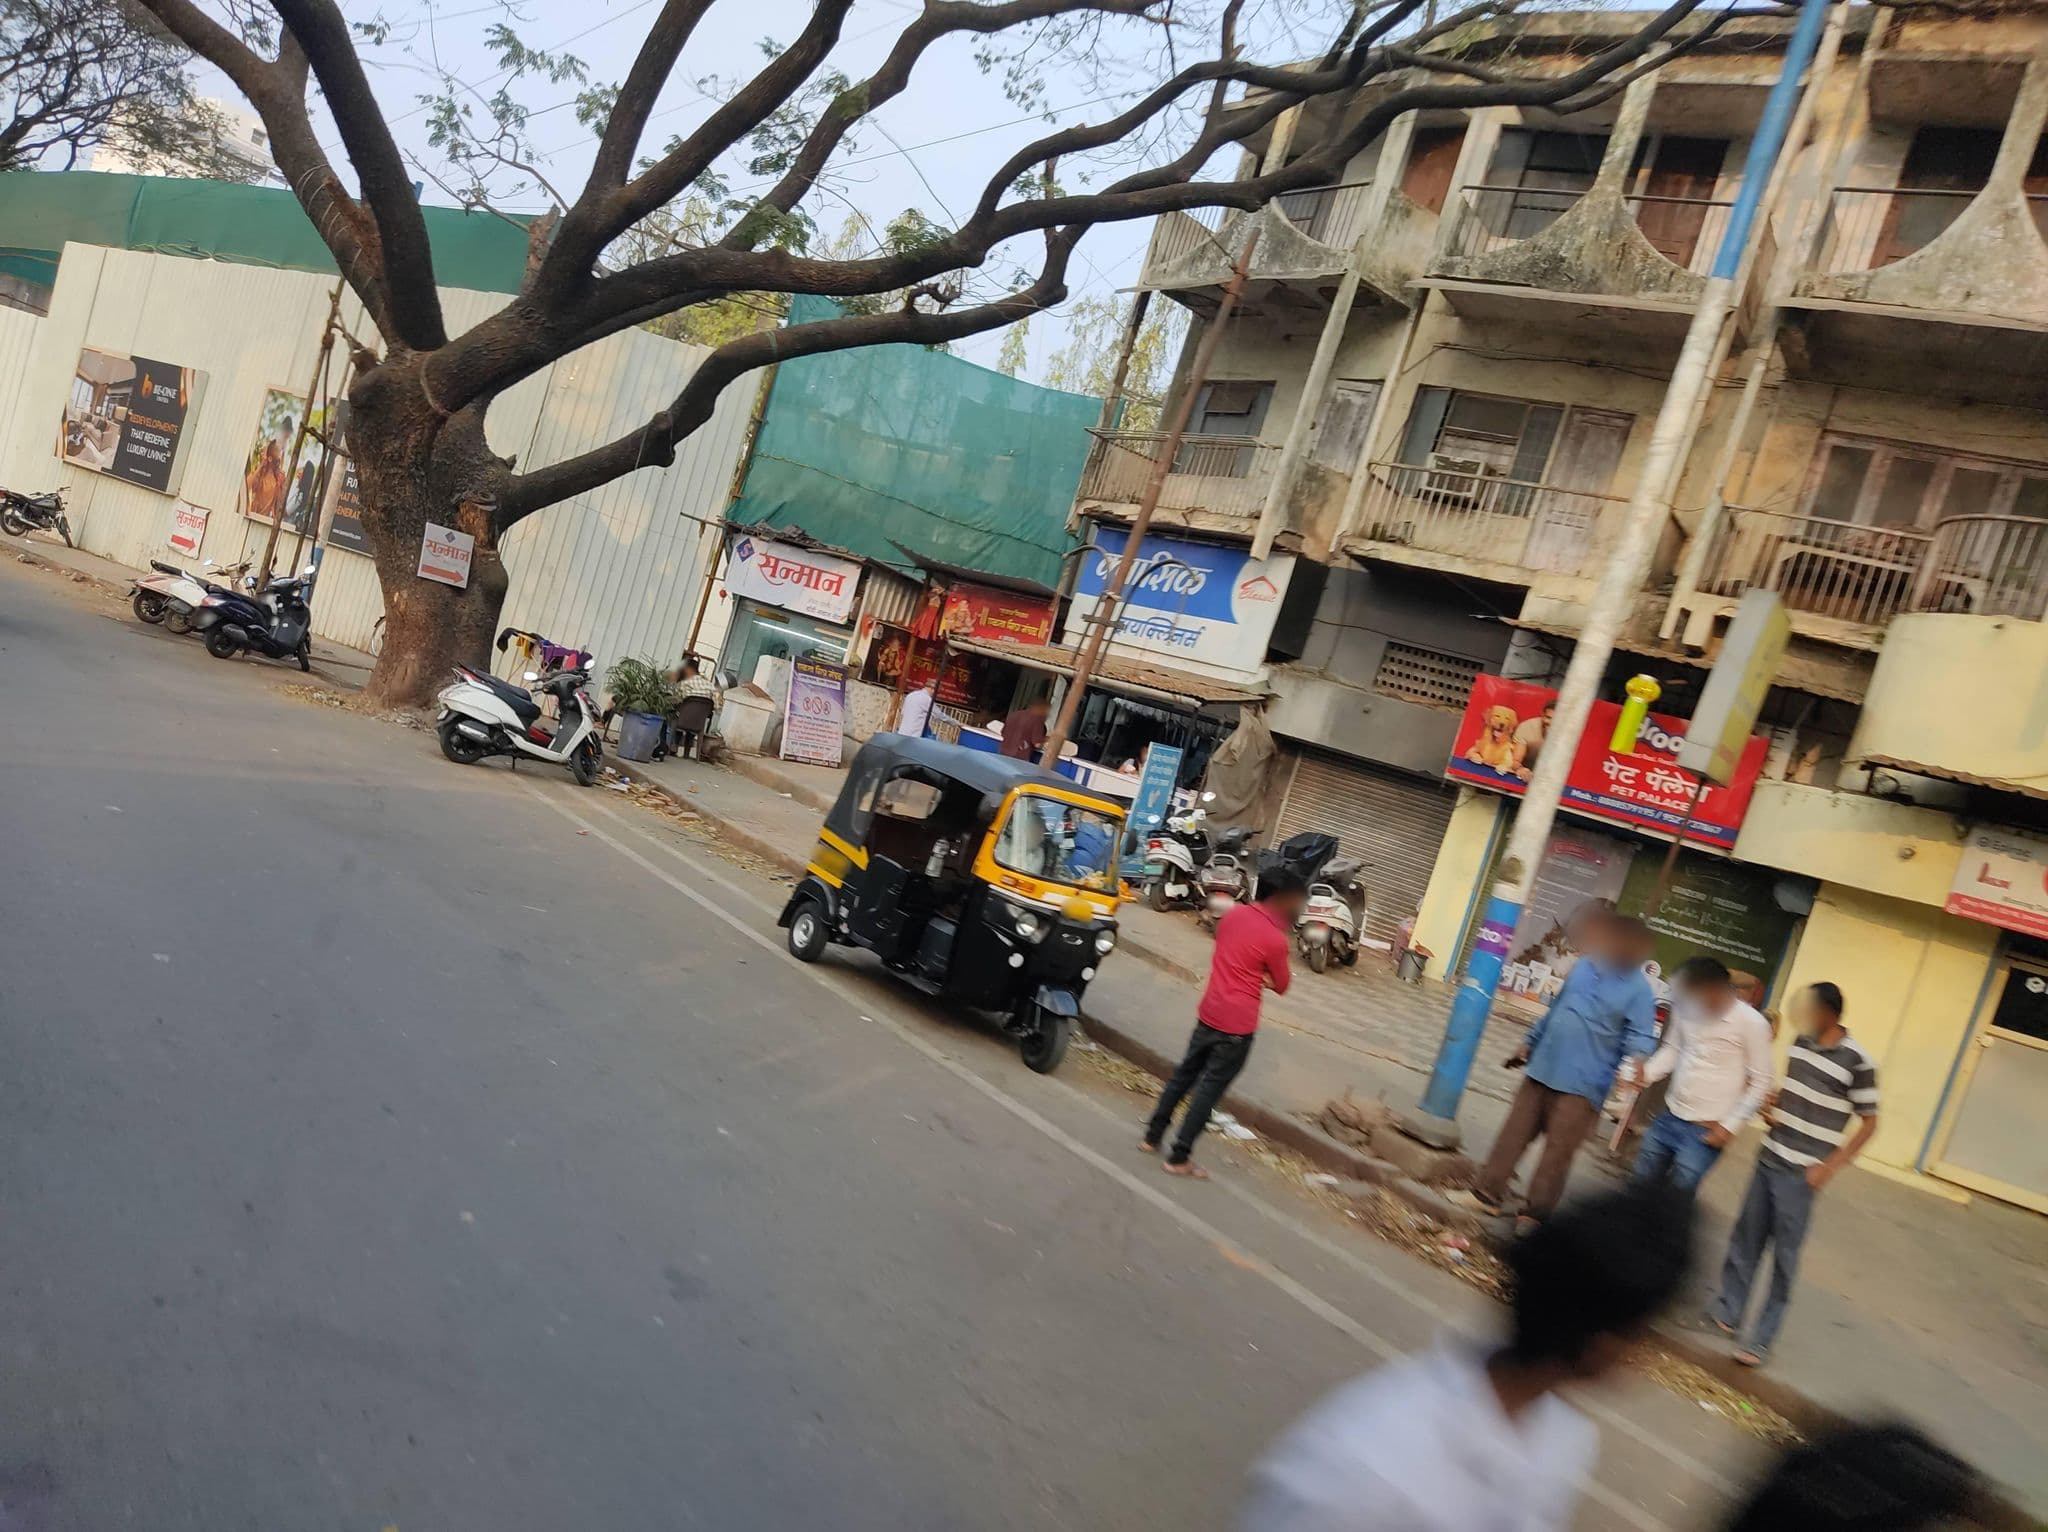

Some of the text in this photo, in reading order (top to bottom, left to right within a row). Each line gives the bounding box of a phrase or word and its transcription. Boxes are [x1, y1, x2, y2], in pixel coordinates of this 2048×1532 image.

[126, 442, 147, 458] LUXURY
[130, 427, 171, 448] THAT REDEFINE
[425, 539, 470, 562] सन्मान
[758, 552, 847, 597] सन्मान
[1636, 716, 1686, 753] droo
[1603, 756, 1640, 785] पेट
[1645, 767, 1713, 803] पॅलेस
[1610, 784, 1690, 811] PET PALACE
